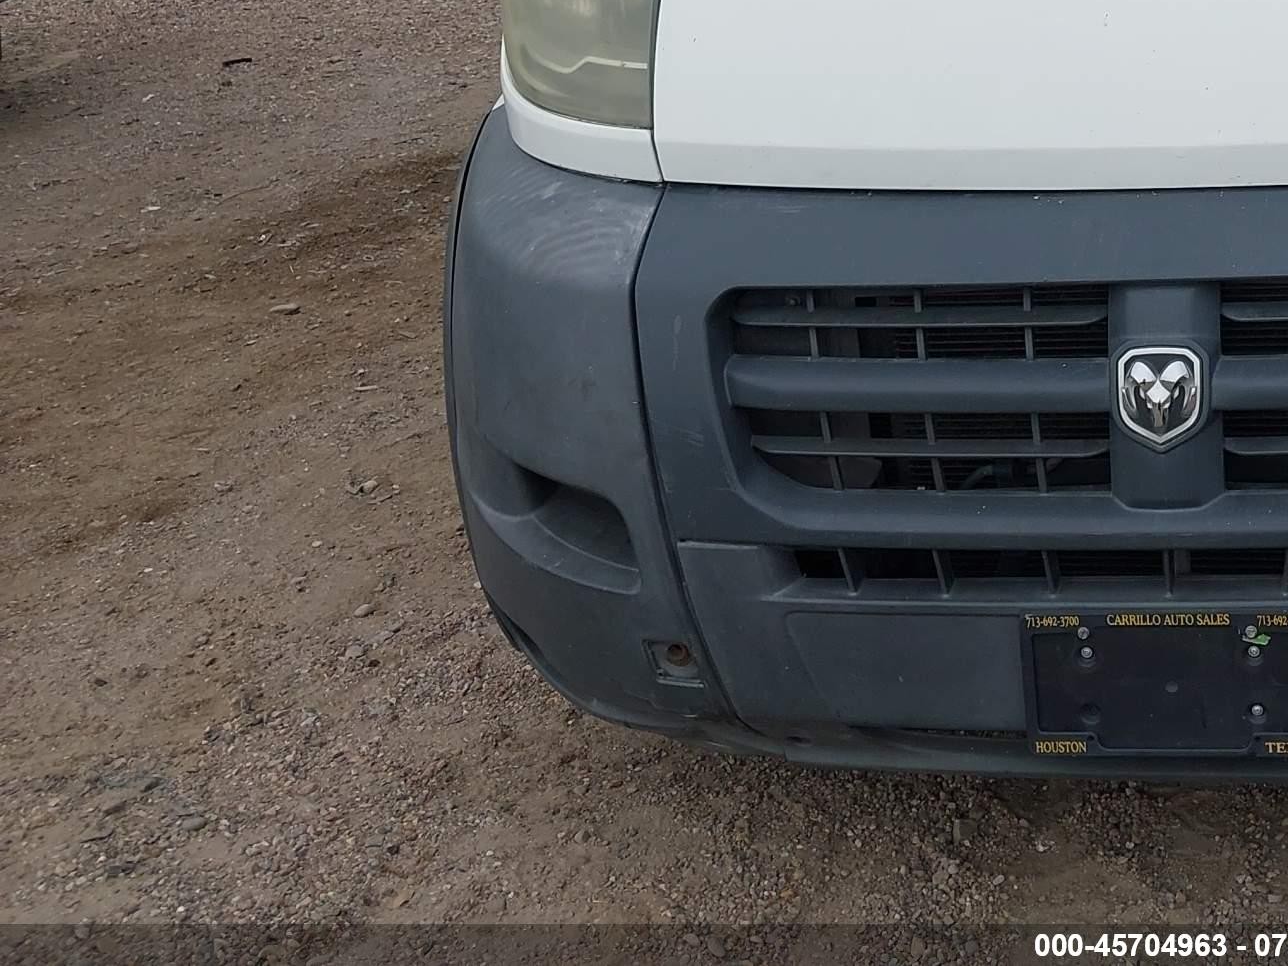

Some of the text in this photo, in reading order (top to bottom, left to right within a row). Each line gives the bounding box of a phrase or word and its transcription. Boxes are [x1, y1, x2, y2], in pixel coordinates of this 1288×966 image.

[1026, 615, 1080, 628] 713-692-3700
[1106, 614, 1230, 626] CARRILLO AUTO SALES
[1035, 741, 1087, 754] HOUSTON
